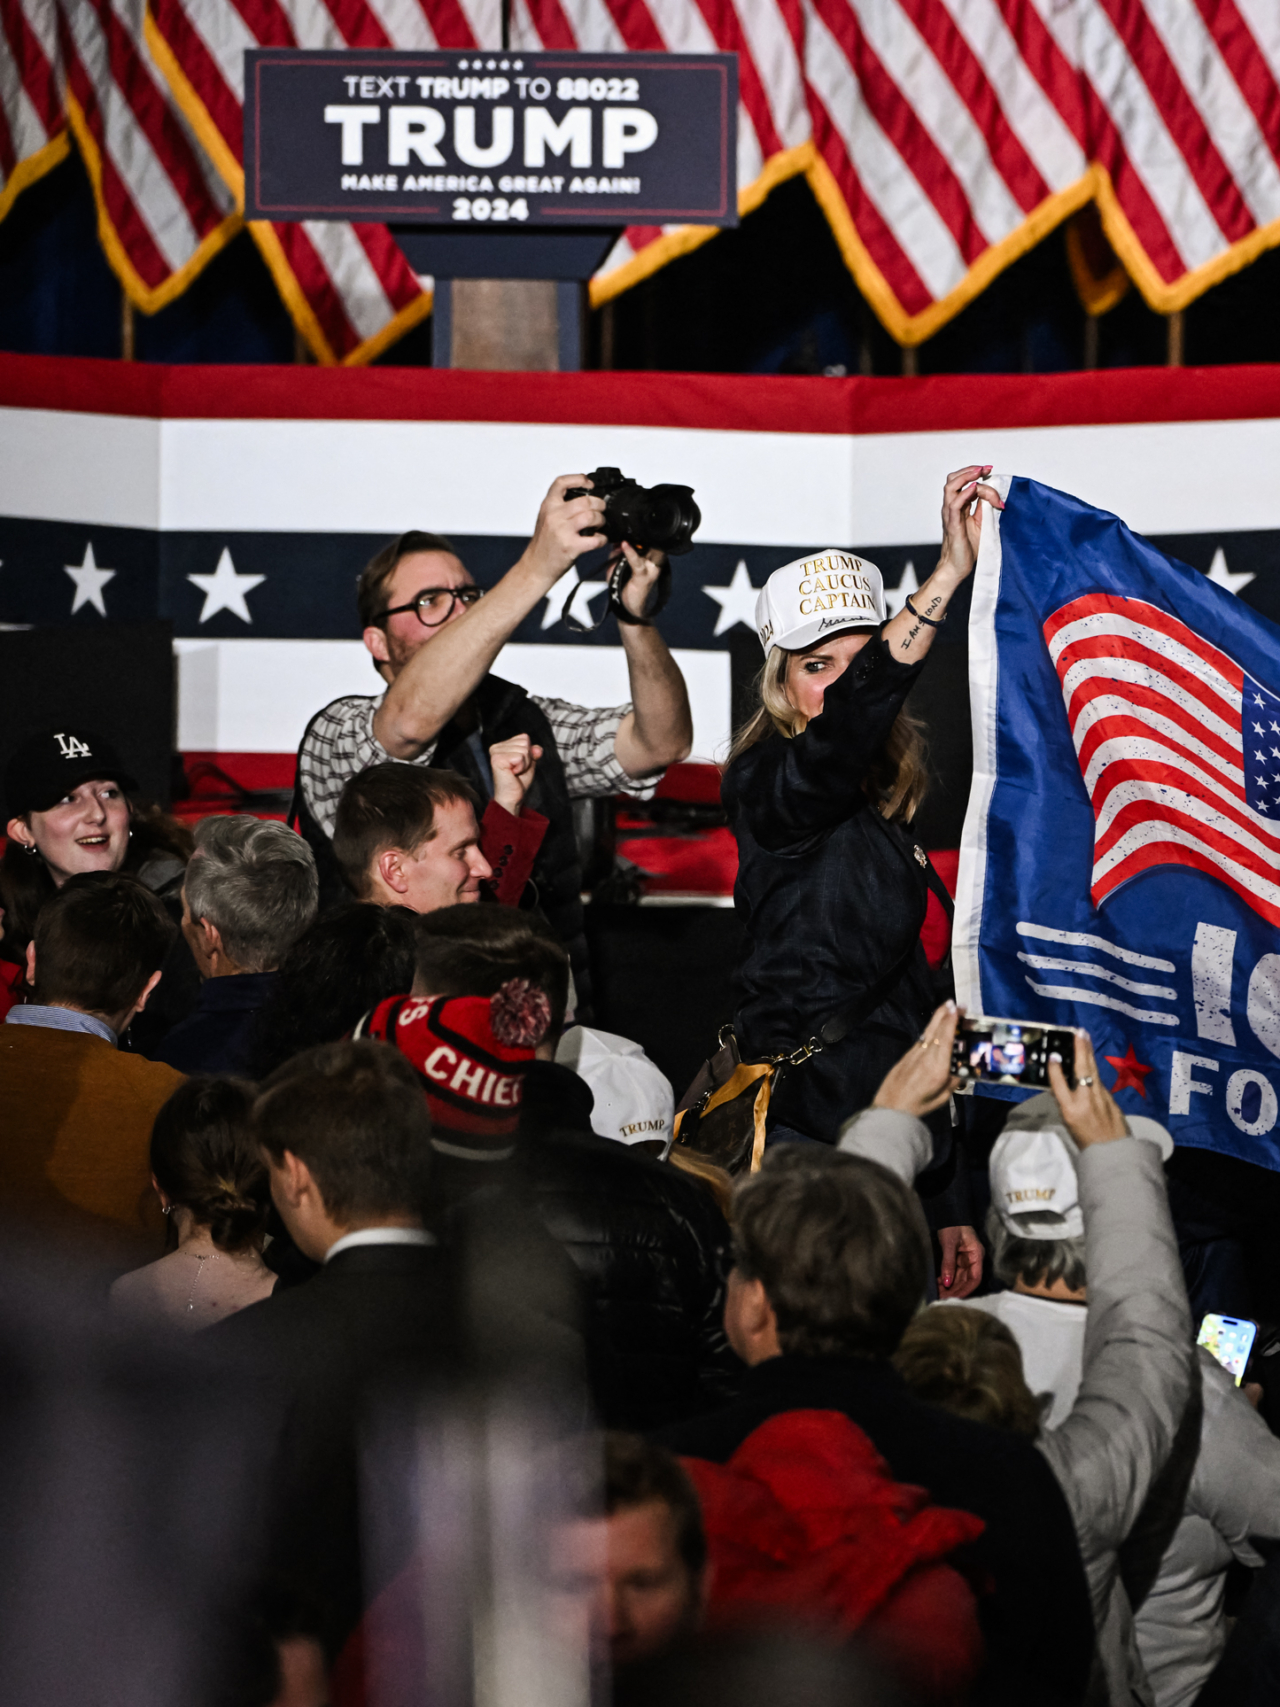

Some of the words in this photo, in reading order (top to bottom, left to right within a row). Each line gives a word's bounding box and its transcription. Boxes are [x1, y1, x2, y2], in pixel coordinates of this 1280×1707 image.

[343, 76, 410, 98] TEXT
[416, 77, 510, 99] TRUMP
[515, 78, 551, 100] TO
[556, 78, 639, 100] 88022
[324, 105, 658, 168] TRUMP
[341, 174, 398, 191] MAKE
[403, 175, 494, 192] AMERICA
[498, 176, 564, 193] GREAT
[569, 177, 640, 194] AGAIN!
[452, 197, 529, 220] 2024
[800, 555, 862, 577] TRUMP
[799, 574, 871, 595] CAUCUS
[799, 593, 876, 615] CAPTAIN
[53, 733, 92, 759] LA
[424, 1045, 520, 1105] CHIE
[619, 1119, 665, 1137] TRUMP
[1006, 1189, 1055, 1203] TRUMP
